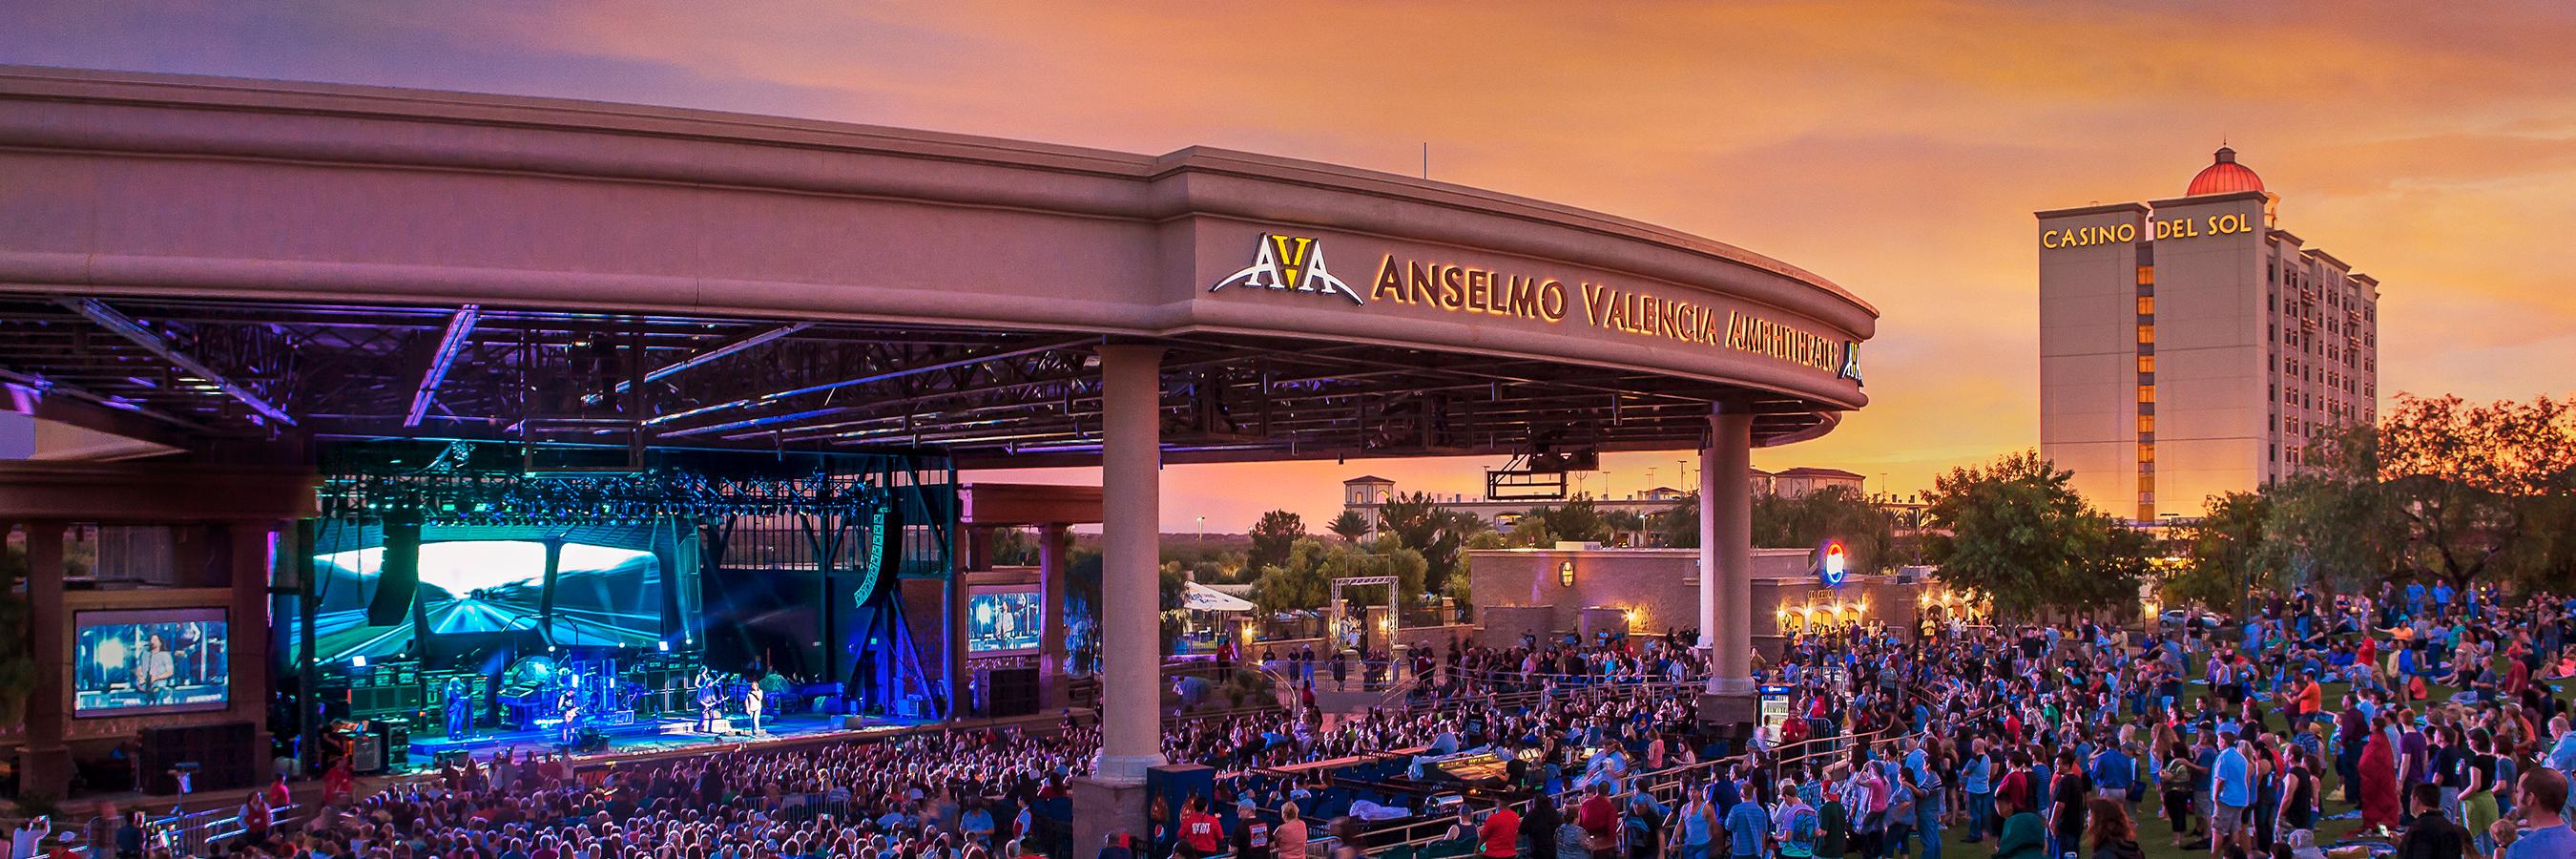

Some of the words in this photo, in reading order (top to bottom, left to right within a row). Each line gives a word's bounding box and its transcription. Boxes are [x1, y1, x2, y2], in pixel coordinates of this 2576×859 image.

[2043, 222, 2136, 250] CASINO
[2156, 218, 2198, 240] DEL
[2208, 213, 2253, 236] SOL
[1371, 254, 1569, 322] ANSELMO
[1581, 283, 1717, 346] VALENCIA
[1725, 309, 1839, 373] AMPHITHEATER
